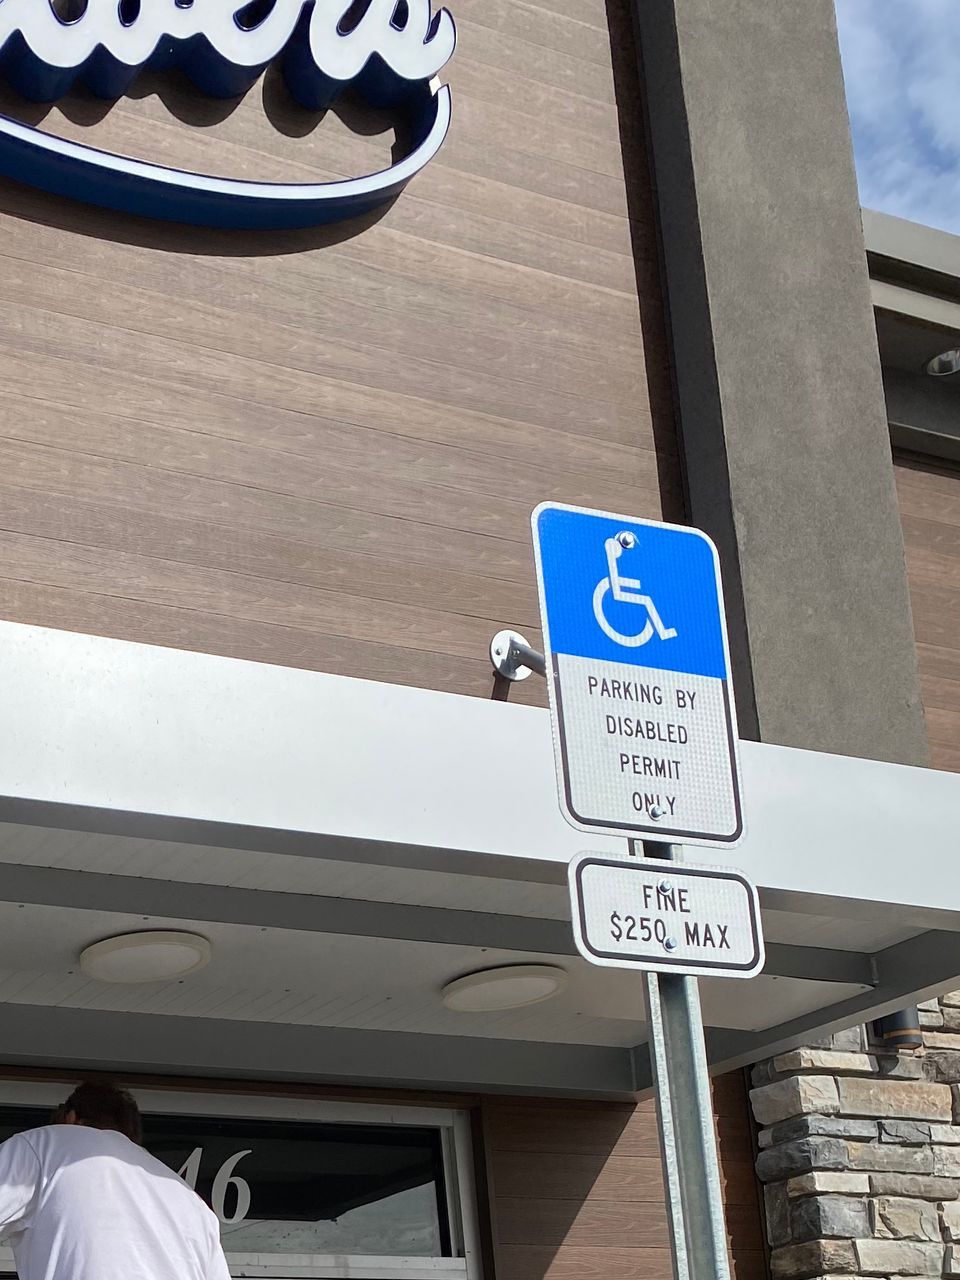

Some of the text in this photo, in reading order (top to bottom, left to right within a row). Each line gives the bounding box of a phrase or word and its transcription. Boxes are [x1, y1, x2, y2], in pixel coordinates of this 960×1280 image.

[588, 676, 696, 710] PARKING BY
[606, 715, 688, 745] DISABLED
[620, 753, 681, 780] PERMIT
[642, 884, 690, 913] FINE
[610, 911, 730, 949] $250 MAX
